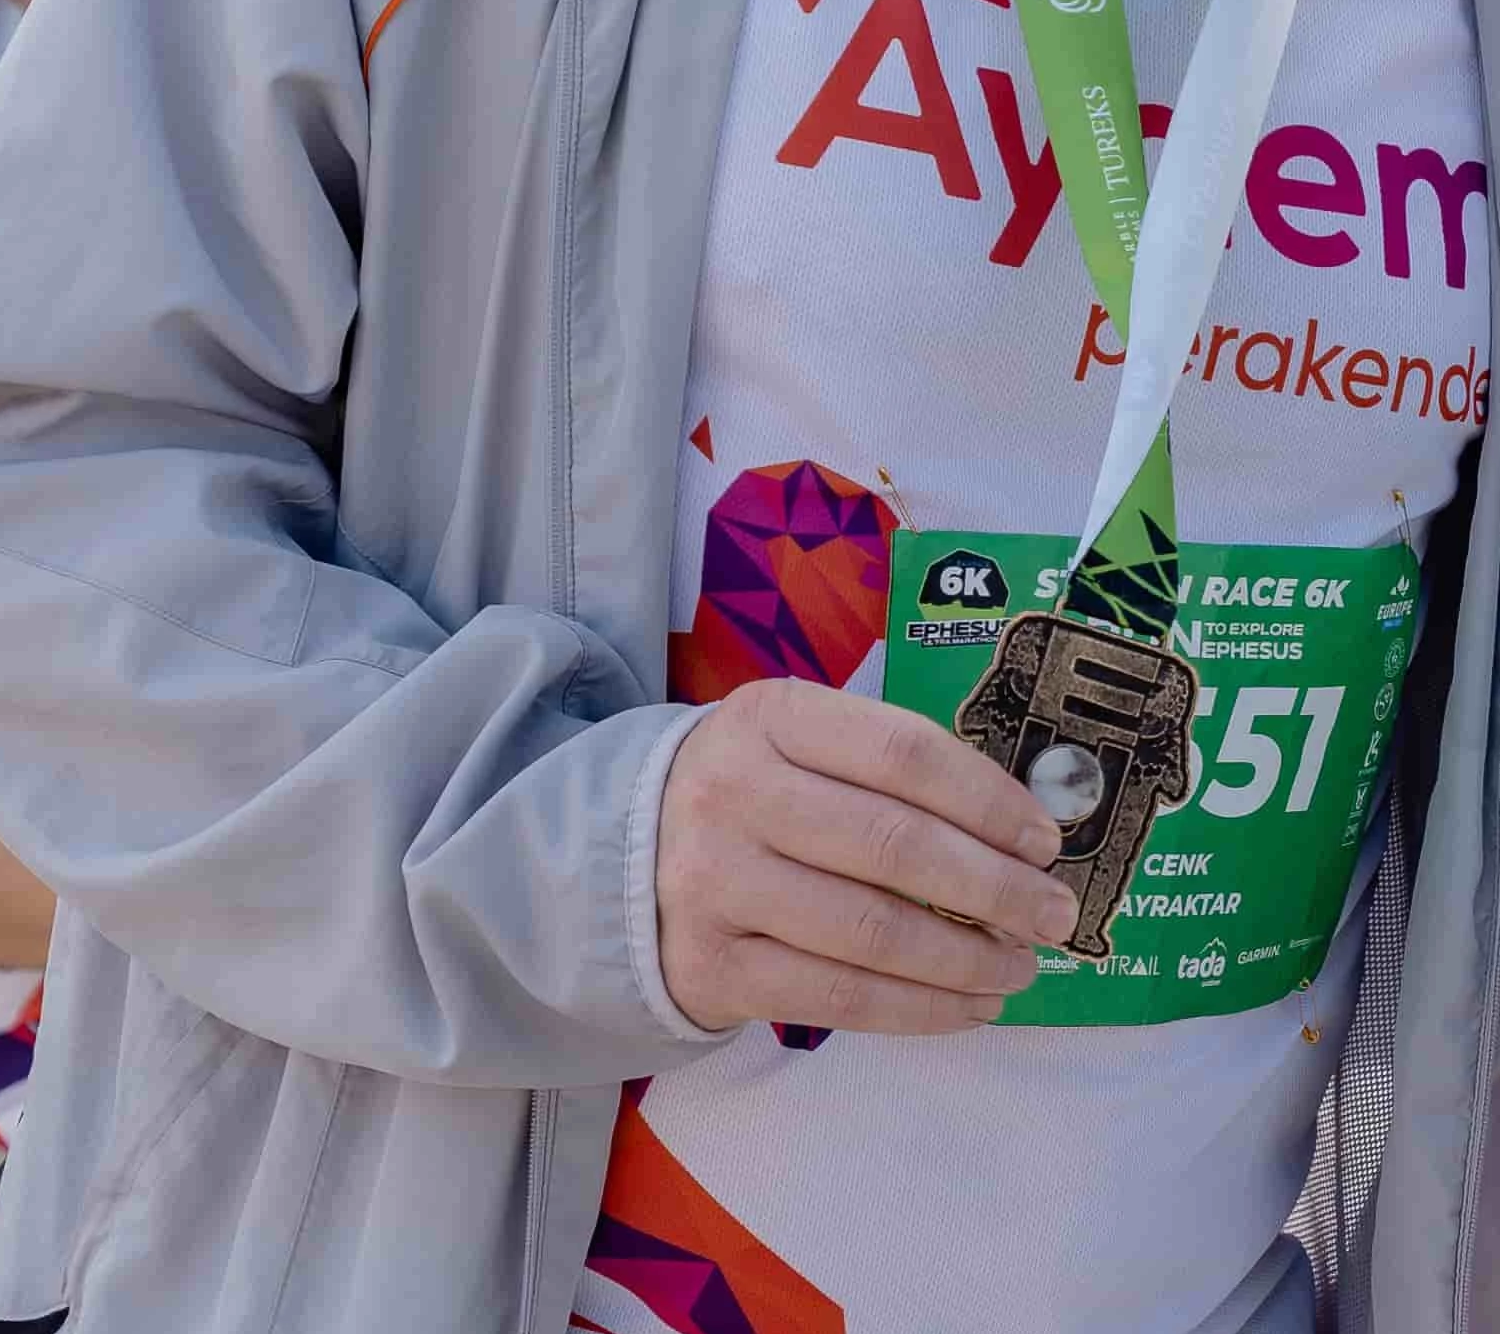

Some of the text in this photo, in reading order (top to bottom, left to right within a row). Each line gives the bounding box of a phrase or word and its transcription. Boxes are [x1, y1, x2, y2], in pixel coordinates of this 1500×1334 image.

[1082, 84, 1131, 191] TUREKS
[939, 565, 992, 598] 6K
[1201, 576, 1299, 608] RACE
[1304, 578, 1352, 609] 6K
[1376, 598, 1415, 621] EUROPE
[1204, 622, 1305, 637] TO EXPLORE
[1201, 641, 1304, 660] EPHESUS
[1143, 852, 1215, 877] CENK
[1114, 892, 1243, 918] AYRAKTAR
[1178, 951, 1228, 980] tada
[1237, 945, 1282, 966] GARMIN
